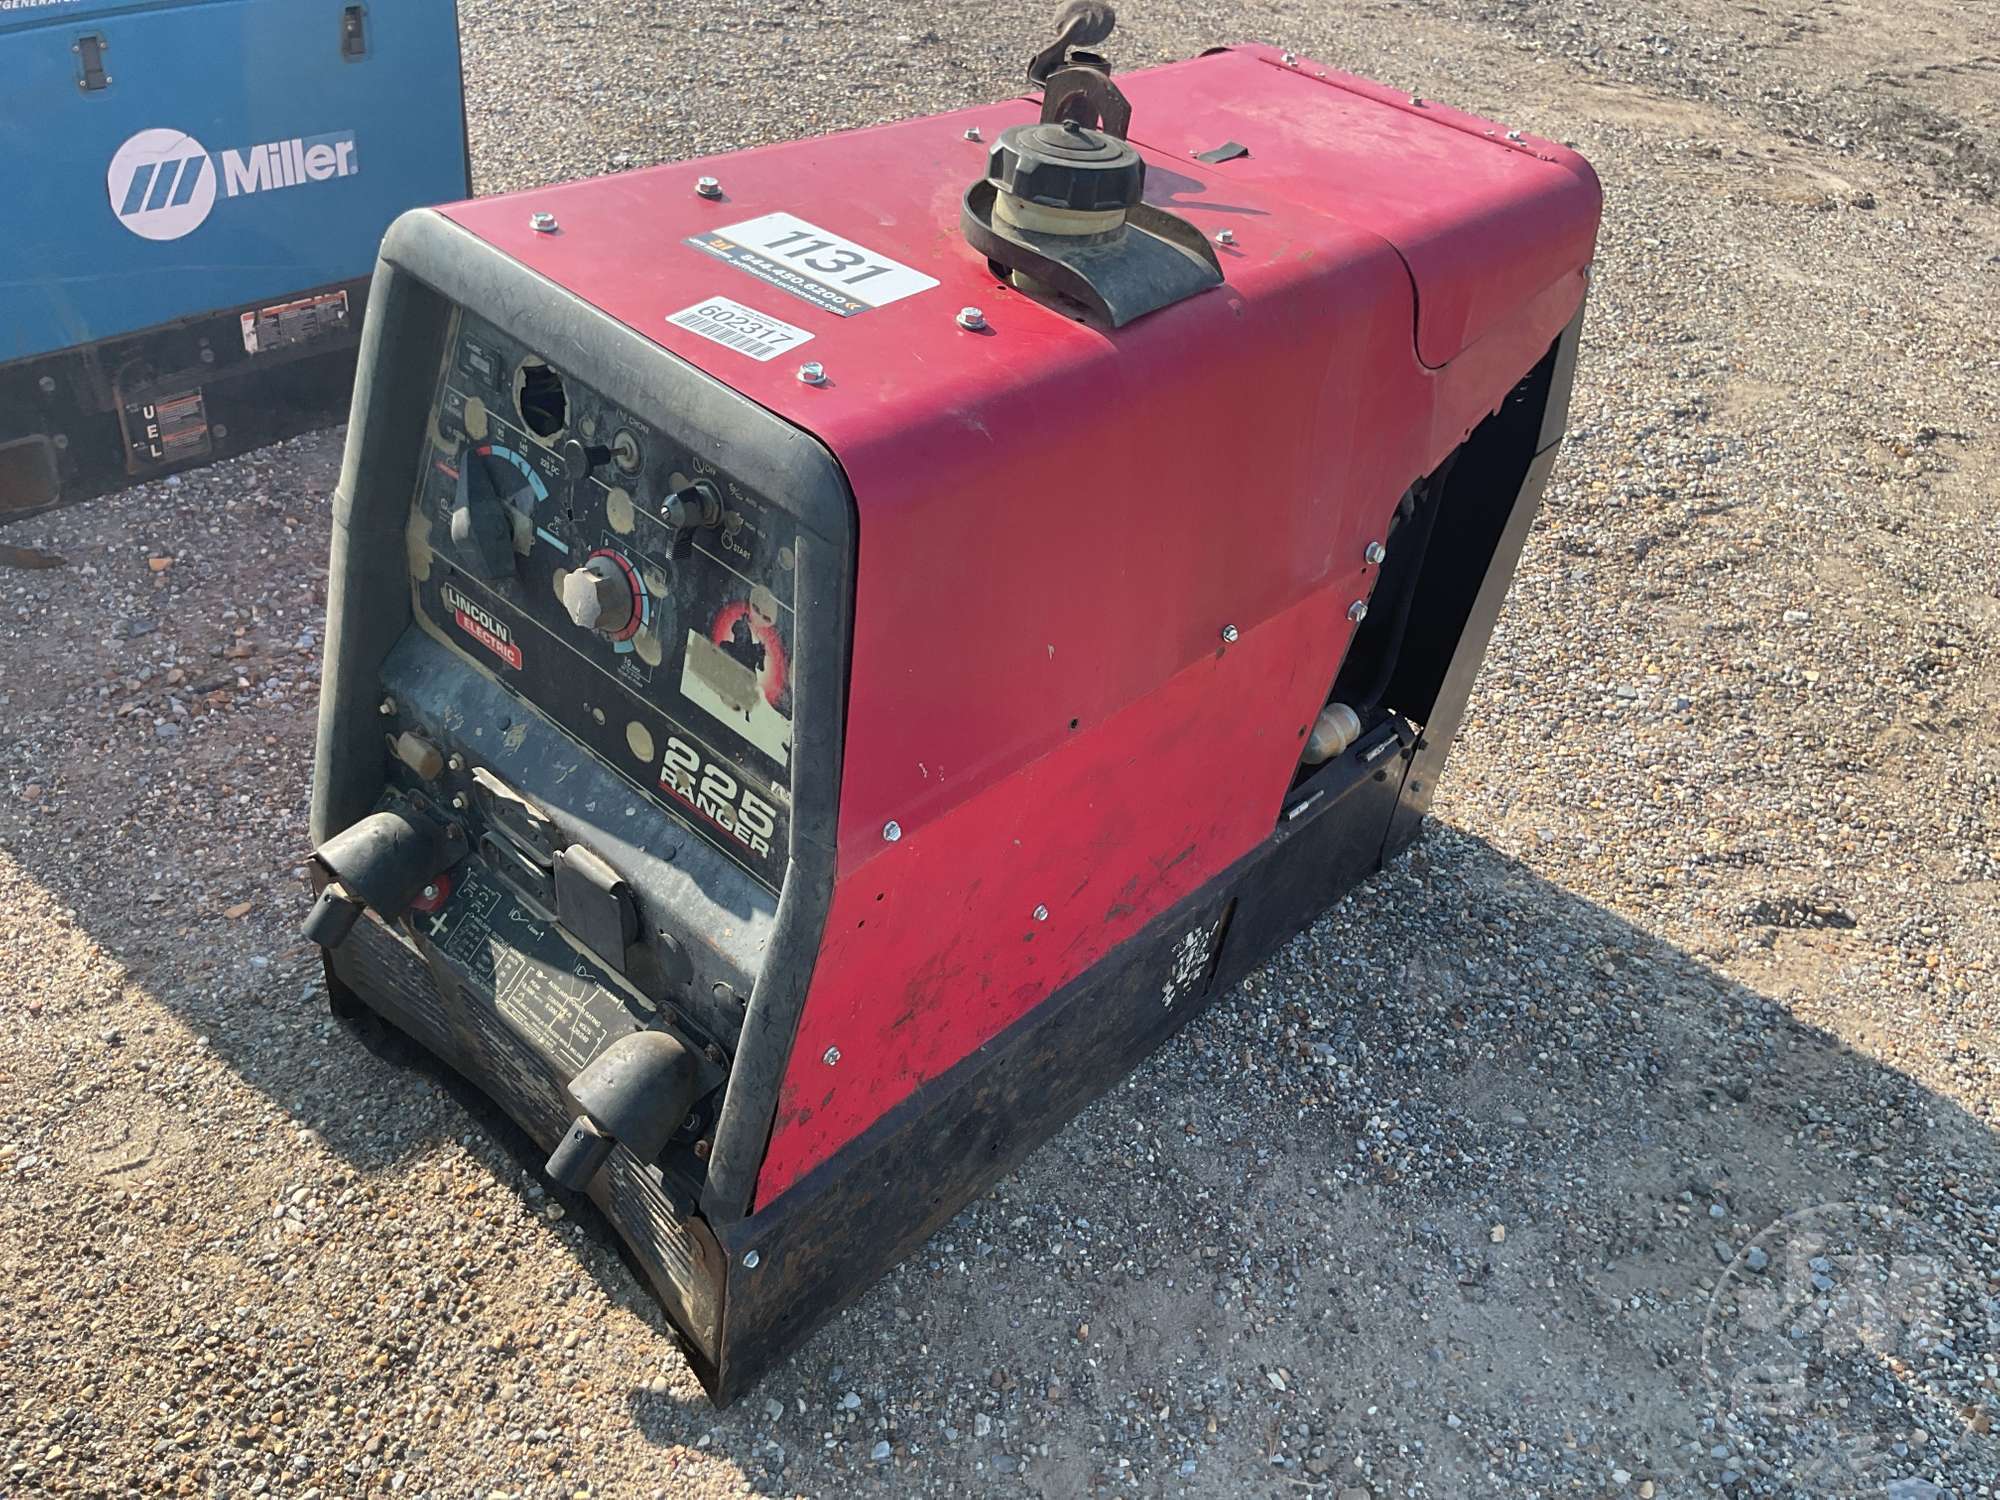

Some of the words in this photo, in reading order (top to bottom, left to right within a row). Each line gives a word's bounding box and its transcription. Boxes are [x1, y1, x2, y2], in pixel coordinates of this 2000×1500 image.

[222, 138, 353, 197] Miller
[763, 230, 893, 284] 1131
[698, 305, 793, 344] 602317
[448, 588, 508, 643] LINCOLN
[463, 616, 516, 662] ELECTRIC
[660, 766, 770, 859] RANGER
[663, 736, 777, 839] 225
